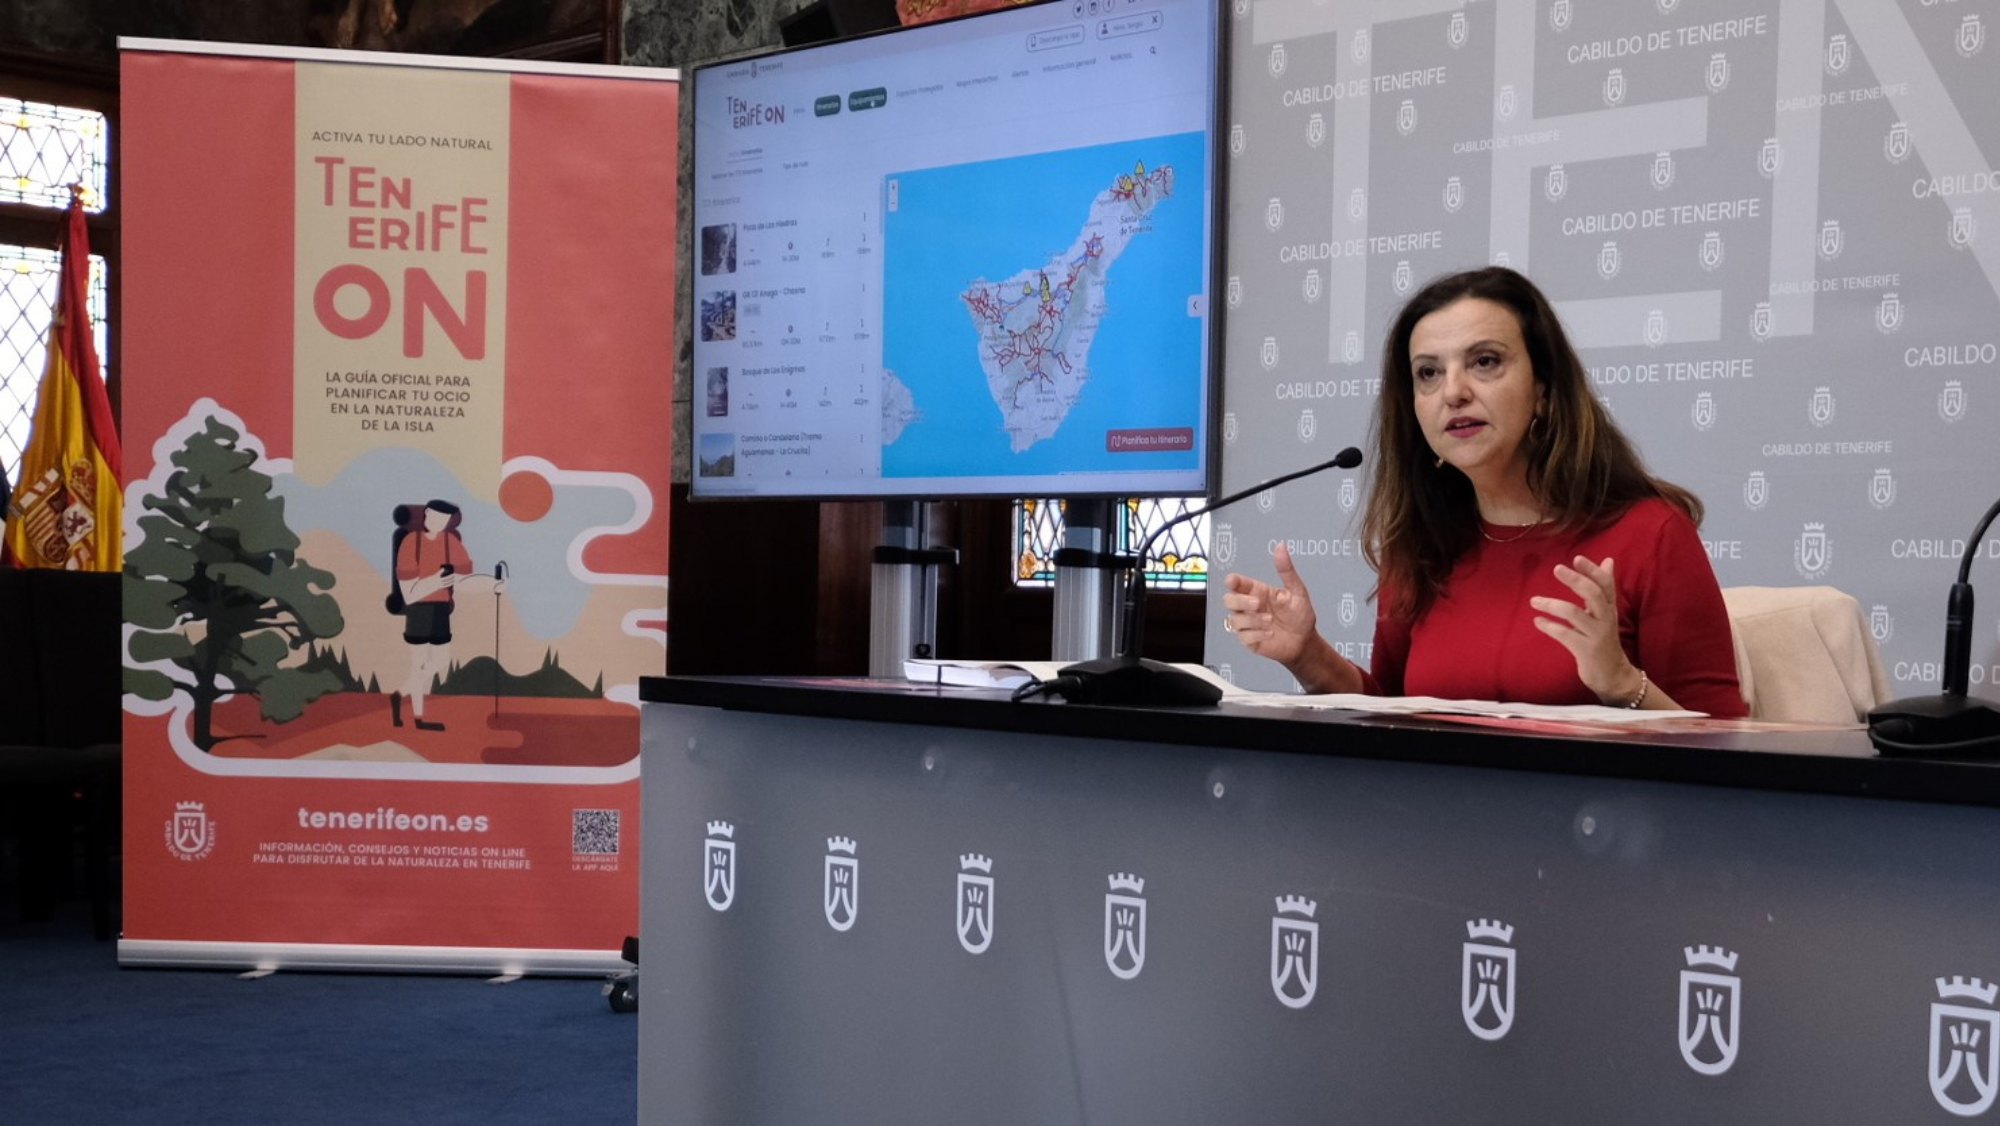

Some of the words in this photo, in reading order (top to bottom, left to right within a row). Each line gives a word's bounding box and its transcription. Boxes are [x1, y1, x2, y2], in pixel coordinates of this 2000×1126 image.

[1567, 35, 1642, 64] CABILDO
[1647, 31, 1671, 52] DE
[1676, 15, 1767, 47] TENERIFE
[1284, 82, 1345, 108] CABILDO
[1350, 78, 1368, 97] DE
[1373, 66, 1446, 93] TENERIFE
[1776, 94, 1826, 112] CABILDO
[1829, 91, 1846, 106] DE
[1850, 82, 1909, 102] TENERIFE
[727, 96, 747, 115] TEN
[733, 104, 762, 129] ERIFE
[764, 104, 785, 124] ON
[312, 131, 363, 143] ACTIVA
[368, 133, 385, 145] TU
[389, 136, 426, 147] LADO
[430, 137, 492, 150] NATURAL
[1454, 138, 1494, 154] CABILDO
[1496, 136, 1510, 148] DE
[1512, 130, 1560, 146] TENERIFE
[314, 156, 411, 210] TEN
[1912, 170, 2000, 198] CABILDO
[348, 198, 488, 254] ERIFE
[1562, 212, 1636, 236] CABILDO
[1642, 208, 1666, 228] DE
[1671, 198, 1760, 224] TENERIFE
[1120, 226, 1127, 234] de
[1280, 242, 1341, 263] CABILDO
[1345, 239, 1364, 256] DE
[1368, 230, 1442, 254] TENERIFE
[1770, 280, 1819, 296] CABILDO
[1823, 278, 1838, 292] DE
[1842, 273, 1901, 290] TENERIFE
[313, 263, 487, 360] ON
[1904, 344, 1996, 367] CABILDO
[326, 372, 340, 382] LA
[344, 370, 377, 384] GUÍA
[382, 374, 432, 386] OFICIAL
[436, 376, 470, 386] PARA
[742, 368, 762, 376] Bosque
[1636, 364, 1660, 383] DE
[1665, 358, 1754, 381] TENERIFE
[326, 388, 406, 400] PLANIFICAR
[412, 390, 428, 400] TU
[434, 391, 470, 402] OCIO
[1276, 380, 1337, 400] CABILDO
[1341, 380, 1360, 396] DE
[330, 403, 348, 414] EN
[354, 404, 370, 414] LA
[375, 404, 464, 418] NATURALEZA
[362, 420, 378, 430] DE
[384, 420, 400, 431] LA
[406, 422, 434, 432] ISLA
[1122, 436, 1149, 446] Planifica
[1150, 436, 1156, 444] tu
[1762, 444, 1812, 456] CABILDO
[1816, 442, 1831, 454] DE
[1835, 441, 1893, 454] TENERIFE
[1268, 540, 1328, 556] CBILDO
[1332, 540, 1350, 556] DE
[1894, 662, 1984, 684] CABIO
[298, 808, 489, 832] tenerifeon.es
[260, 841, 344, 854] INFORMACIÓN,
[348, 844, 410, 856] CONSEJOS
[412, 845, 420, 856] Y
[424, 846, 478, 857] NOTICIAS
[481, 848, 498, 858] ON
[502, 848, 526, 858] LINE
[254, 854, 284, 864] PARA
[288, 854, 350, 866] DISFRUTAR
[354, 856, 368, 866] DE
[371, 856, 384, 866] LA
[388, 856, 460, 868] NATURALEZA
[463, 858, 478, 868] EN
[482, 859, 531, 870] TENERIFE
